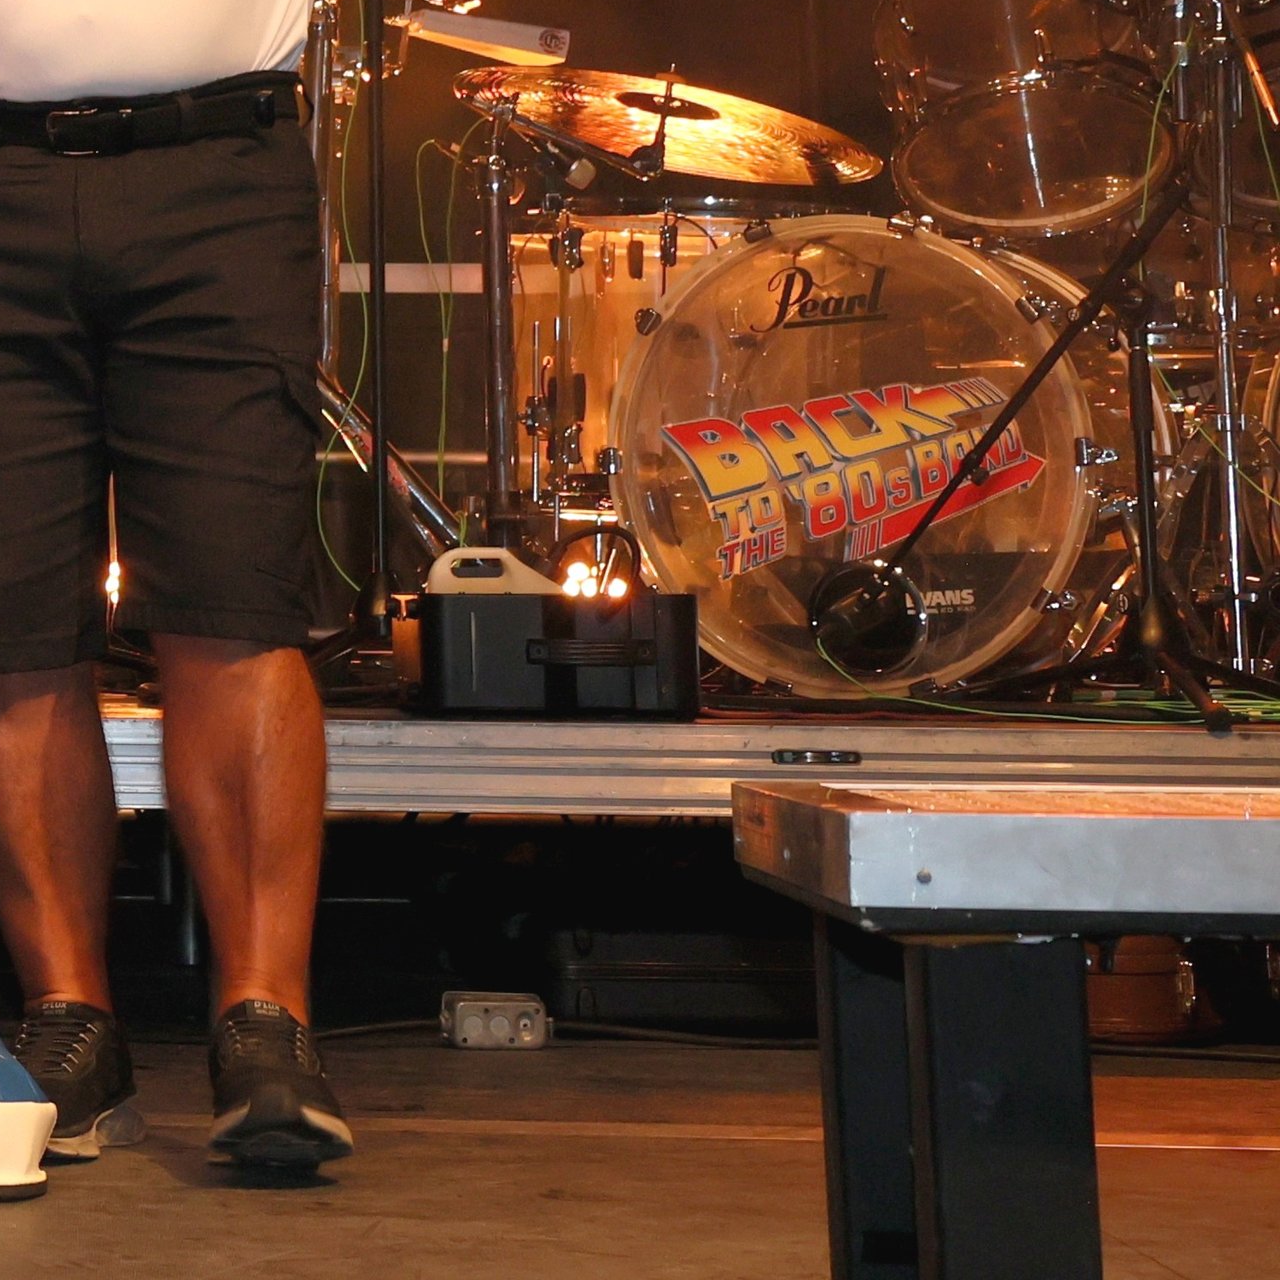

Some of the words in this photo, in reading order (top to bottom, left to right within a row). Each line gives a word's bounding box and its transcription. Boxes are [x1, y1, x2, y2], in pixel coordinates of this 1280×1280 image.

[750, 264, 887, 333] Pearl
[660, 383, 958, 501] BACK
[712, 488, 784, 541] TO
[718, 526, 786, 580] THE
